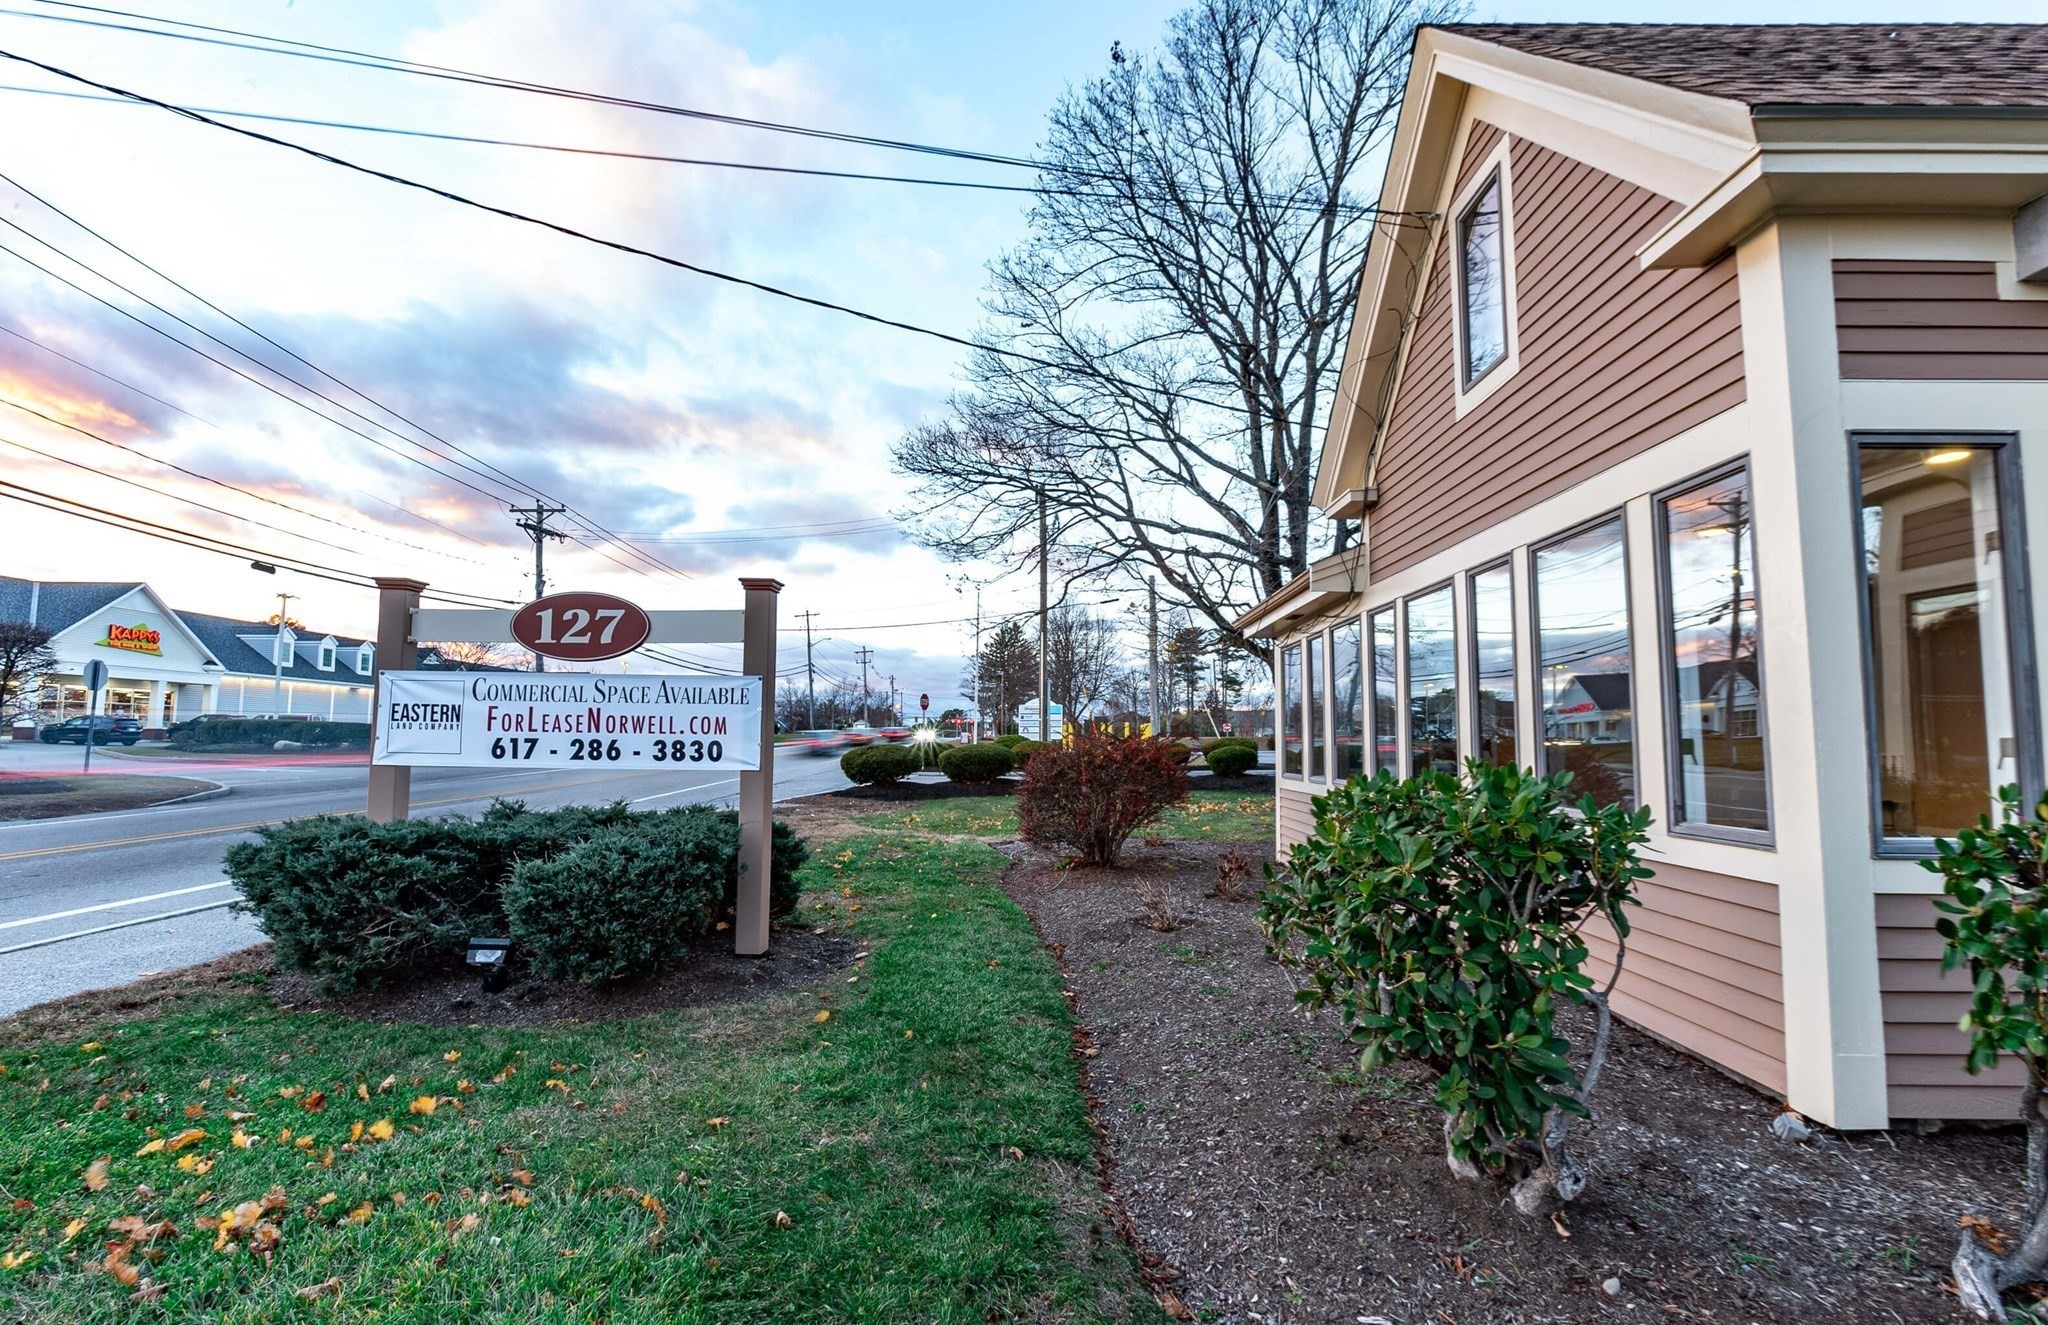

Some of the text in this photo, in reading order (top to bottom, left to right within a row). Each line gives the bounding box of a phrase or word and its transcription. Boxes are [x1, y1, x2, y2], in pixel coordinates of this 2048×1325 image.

[534, 608, 626, 644] 127
[391, 703, 461, 722] EASTERN
[391, 722, 413, 730] LAND
